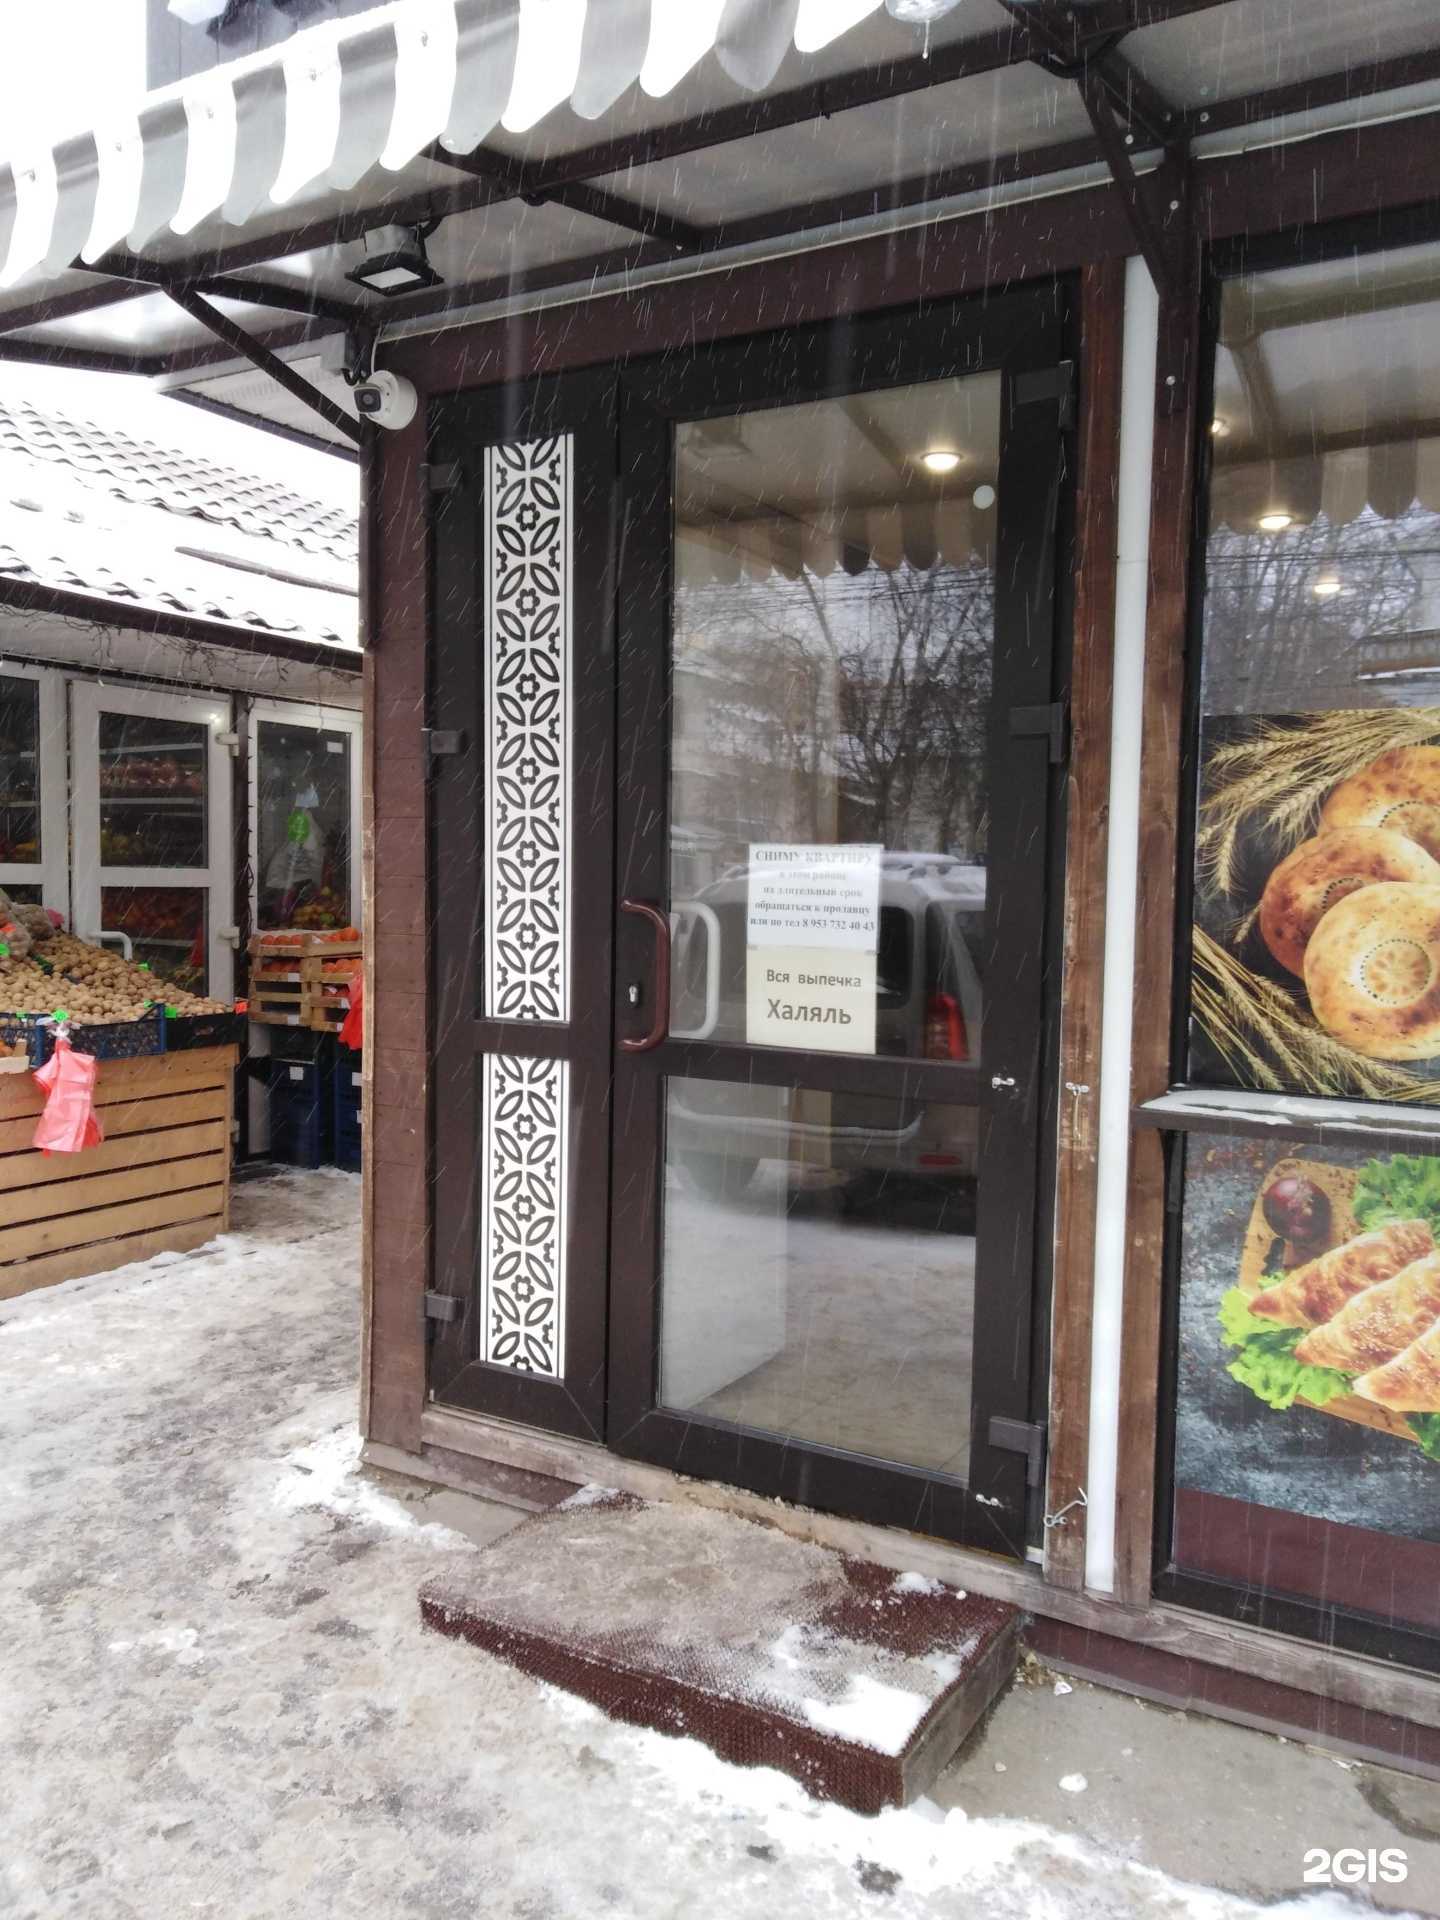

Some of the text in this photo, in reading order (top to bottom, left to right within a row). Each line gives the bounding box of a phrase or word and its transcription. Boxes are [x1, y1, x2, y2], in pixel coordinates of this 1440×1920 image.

[756, 851, 871, 863] СНИМУ КВАРТИРУ
[763, 886, 863, 900] на длительный срок
[755, 901, 811, 912] обращаться
[823, 905, 870, 915] продавцу
[750, 918, 768, 926] или
[770, 919, 782, 927] по
[785, 921, 800, 929] тел
[802, 919, 809, 928] 8
[810, 919, 827, 929] 953
[848, 921, 861, 930] 40
[863, 921, 875, 931] 43
[767, 969, 862, 987] Вся выпечка
[767, 998, 852, 1024] Халяль
